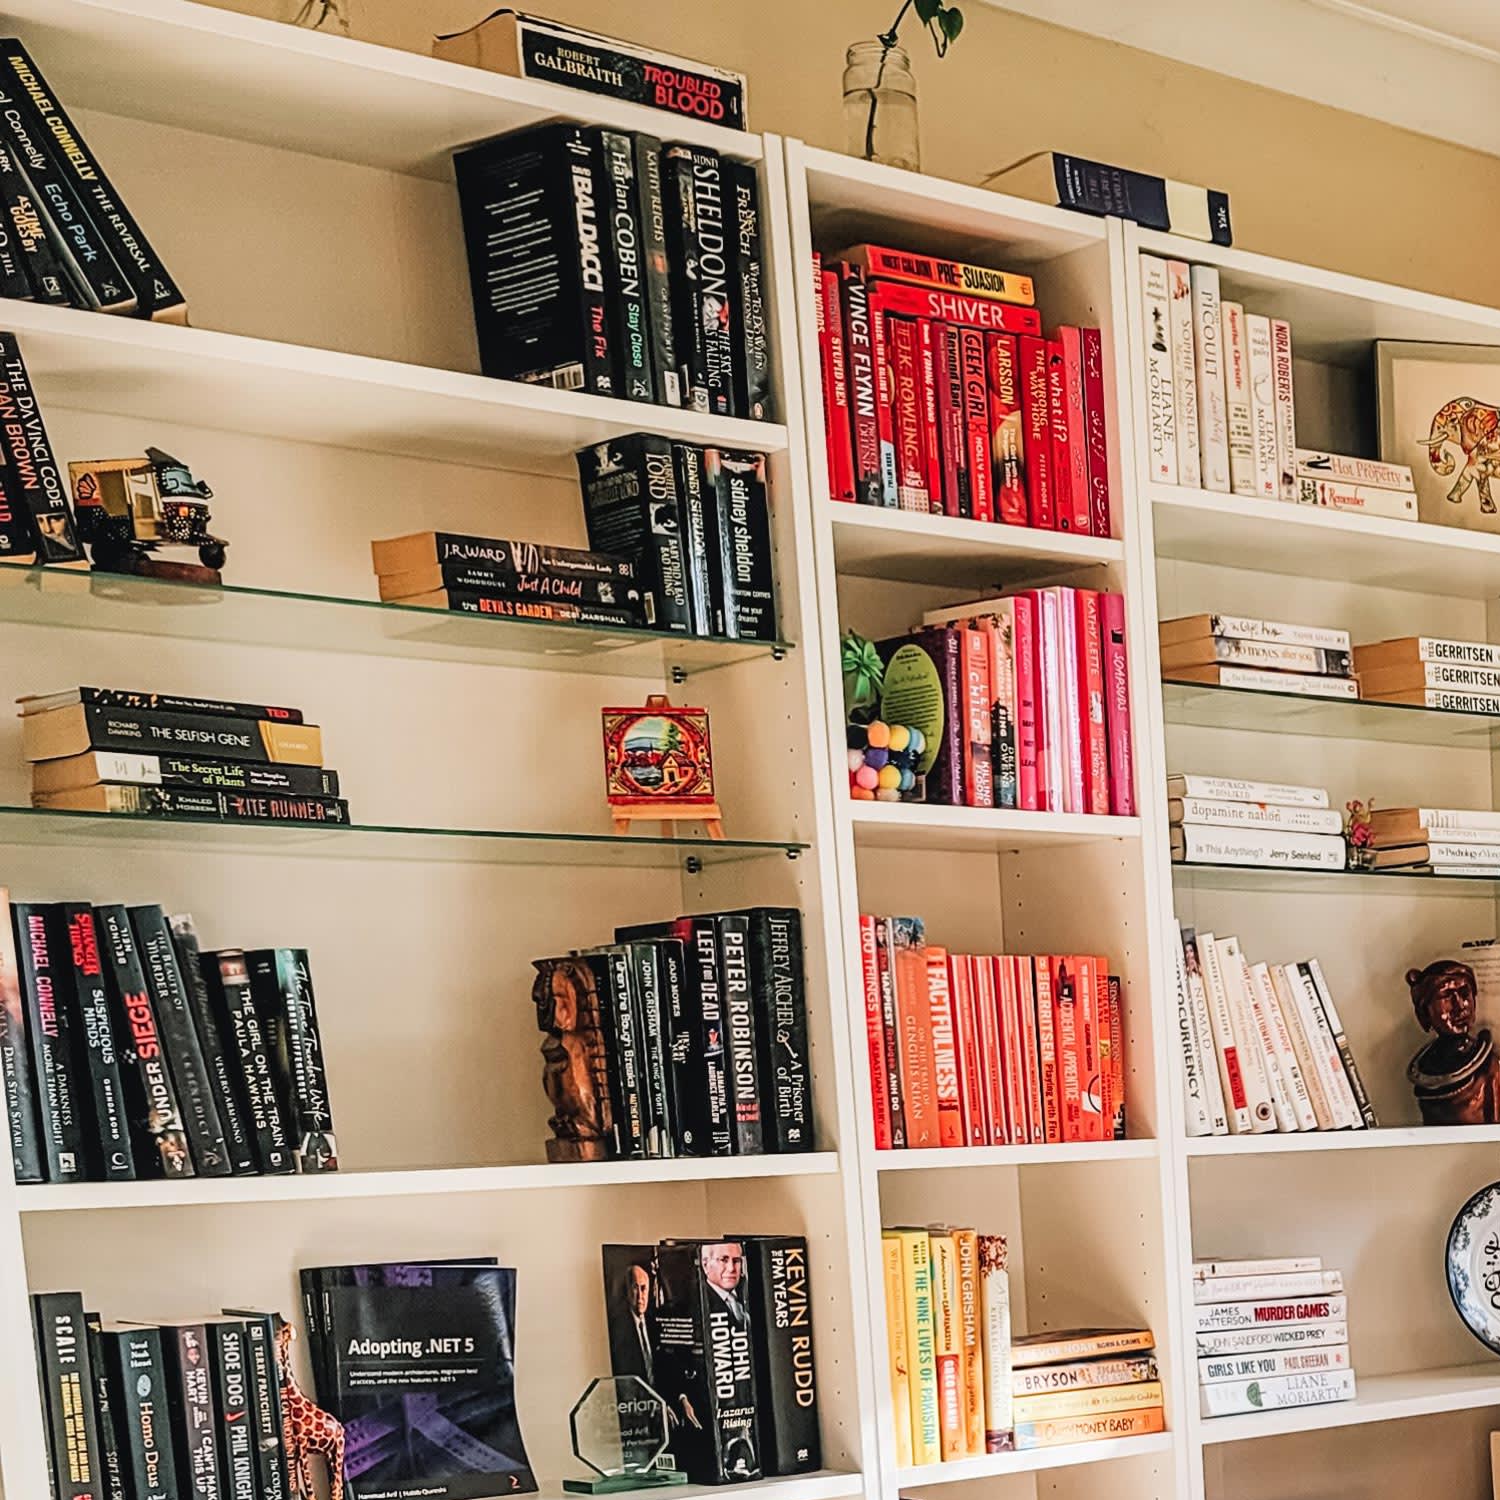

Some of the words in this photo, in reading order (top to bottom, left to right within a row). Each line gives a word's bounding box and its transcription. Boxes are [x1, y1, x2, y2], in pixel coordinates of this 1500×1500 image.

[534, 52, 623, 88] GALBRAITH
[556, 47, 600, 66] ROBERT
[643, 65, 721, 99] TROUBLED
[655, 86, 724, 120] BLOOD
[4, 109, 47, 171] Connelly
[8, 55, 52, 117] MICHAEL
[46, 116, 98, 181] CONNELLY
[92, 184, 113, 214] THE
[109, 213, 151, 272] REVERSAL
[612, 151, 630, 210] Harlan
[45, 183, 72, 222] Echo
[67, 225, 96, 262] Park
[694, 165, 727, 300] SHELDON
[736, 185, 750, 256] FRENCH
[1219, 207, 1227, 230] Yale
[615, 212, 640, 297] COBEN
[937, 262, 1005, 294] PRE-SUASION
[628, 303, 640, 335] Stay
[848, 284, 868, 346] VINCE
[928, 294, 1005, 327] SHIVER
[630, 333, 643, 367] Close
[1201, 290, 1218, 378] PICOULT
[1275, 324, 1289, 355] NORA
[6, 359, 27, 391] THE
[997, 339, 1015, 406] LARSSON
[1035, 349, 1046, 372] THE
[1276, 356, 1291, 402] ROBERTS
[0, 382, 19, 419] DAN
[853, 350, 873, 416] FLYNN
[1029, 371, 1038, 401] WAY
[1037, 376, 1048, 427] WRONG
[17, 396, 35, 418] DA
[1031, 404, 1041, 441] HOME
[6, 425, 40, 490] BROWN
[25, 420, 49, 466] VINCI
[40, 467, 63, 508] CODE
[646, 452, 667, 505] LORD
[730, 478, 750, 524] sidney
[735, 526, 754, 582] sheldon
[517, 575, 539, 592] Just
[540, 578, 549, 594] A
[552, 578, 582, 597] Child
[1087, 596, 1100, 640] KATHY
[1089, 644, 1100, 675] LETTE
[1436, 643, 1493, 662] GERRITSEN
[1442, 668, 1500, 686] GERRITSEN
[970, 673, 981, 730] CHILD
[980, 685, 990, 722] LEE
[1442, 695, 1499, 712] GERRITSEN
[150, 726, 174, 740] THE
[175, 728, 215, 744] SELFISH
[218, 733, 250, 747] GENE
[169, 762, 190, 772] The
[193, 764, 222, 774] Secret
[225, 766, 244, 777] Life
[202, 775, 213, 784] of
[215, 776, 246, 787] Plants
[1192, 802, 1244, 820] dopamine
[1248, 809, 1281, 822] nation
[1205, 845, 1223, 854] This
[1270, 849, 1289, 860] Jerry
[1291, 852, 1321, 861] Seinfeld
[28, 915, 51, 970] MICHAEL
[697, 930, 714, 964] LEFT
[769, 916, 790, 971] JEFFREY
[724, 932, 746, 992] PETER
[240, 988, 253, 1014] THE
[701, 982, 720, 1020] DEAD
[776, 973, 794, 1027] ARCHER
[864, 957, 878, 1012] THINGS
[36, 976, 59, 1038] CONNELLY
[1040, 984, 1054, 1061] GERRITSEN
[1194, 987, 1211, 1050] NOMAD
[84, 1007, 100, 1048] MINDS
[92, 990, 114, 1064] SUSPICIOUS
[246, 1018, 258, 1052] GIRL
[928, 969, 957, 1099] FACTFULNESS
[255, 1054, 267, 1074] ON
[730, 1000, 755, 1100] ROBINSON
[232, 1010, 249, 1058] PAULA
[244, 1064, 266, 1129] HAWKINS
[776, 1066, 787, 1086] of
[259, 1077, 272, 1101] THE
[777, 1088, 790, 1118] Birth
[266, 1102, 284, 1147] TRAIN
[771, 1258, 785, 1280] PM
[784, 1248, 809, 1326] KEVIN
[914, 1268, 927, 1292] THE
[774, 1284, 789, 1328] YEARS
[916, 1294, 928, 1324] NINE
[1199, 1316, 1251, 1328] PATTERSON
[1210, 1307, 1239, 1316] JAMES
[1254, 1306, 1295, 1322] MURDER
[1296, 1303, 1329, 1319] GAMES
[55, 1315, 76, 1364] SCALE
[222, 1332, 240, 1372] SHOE
[349, 1338, 422, 1358] Adopting
[425, 1338, 461, 1353] .NET
[465, 1337, 475, 1352] 5
[710, 1312, 735, 1400] HOWARD
[731, 1327, 750, 1381] JOHN
[917, 1326, 931, 1364] LIVES
[185, 1371, 198, 1403] HART
[195, 1368, 209, 1405] KEVIN
[791, 1336, 814, 1408] RUDD
[920, 1367, 932, 1384] OF
[1025, 1370, 1078, 1389] BRYSON
[1208, 1364, 1234, 1378] GIRLS
[1236, 1362, 1256, 1375] LIKE
[1258, 1359, 1276, 1371] YOU
[1287, 1375, 1328, 1390] LIANE
[226, 1376, 244, 1407] DOG
[920, 1384, 935, 1446] PAKISTAN
[231, 1425, 246, 1453] PHIL
